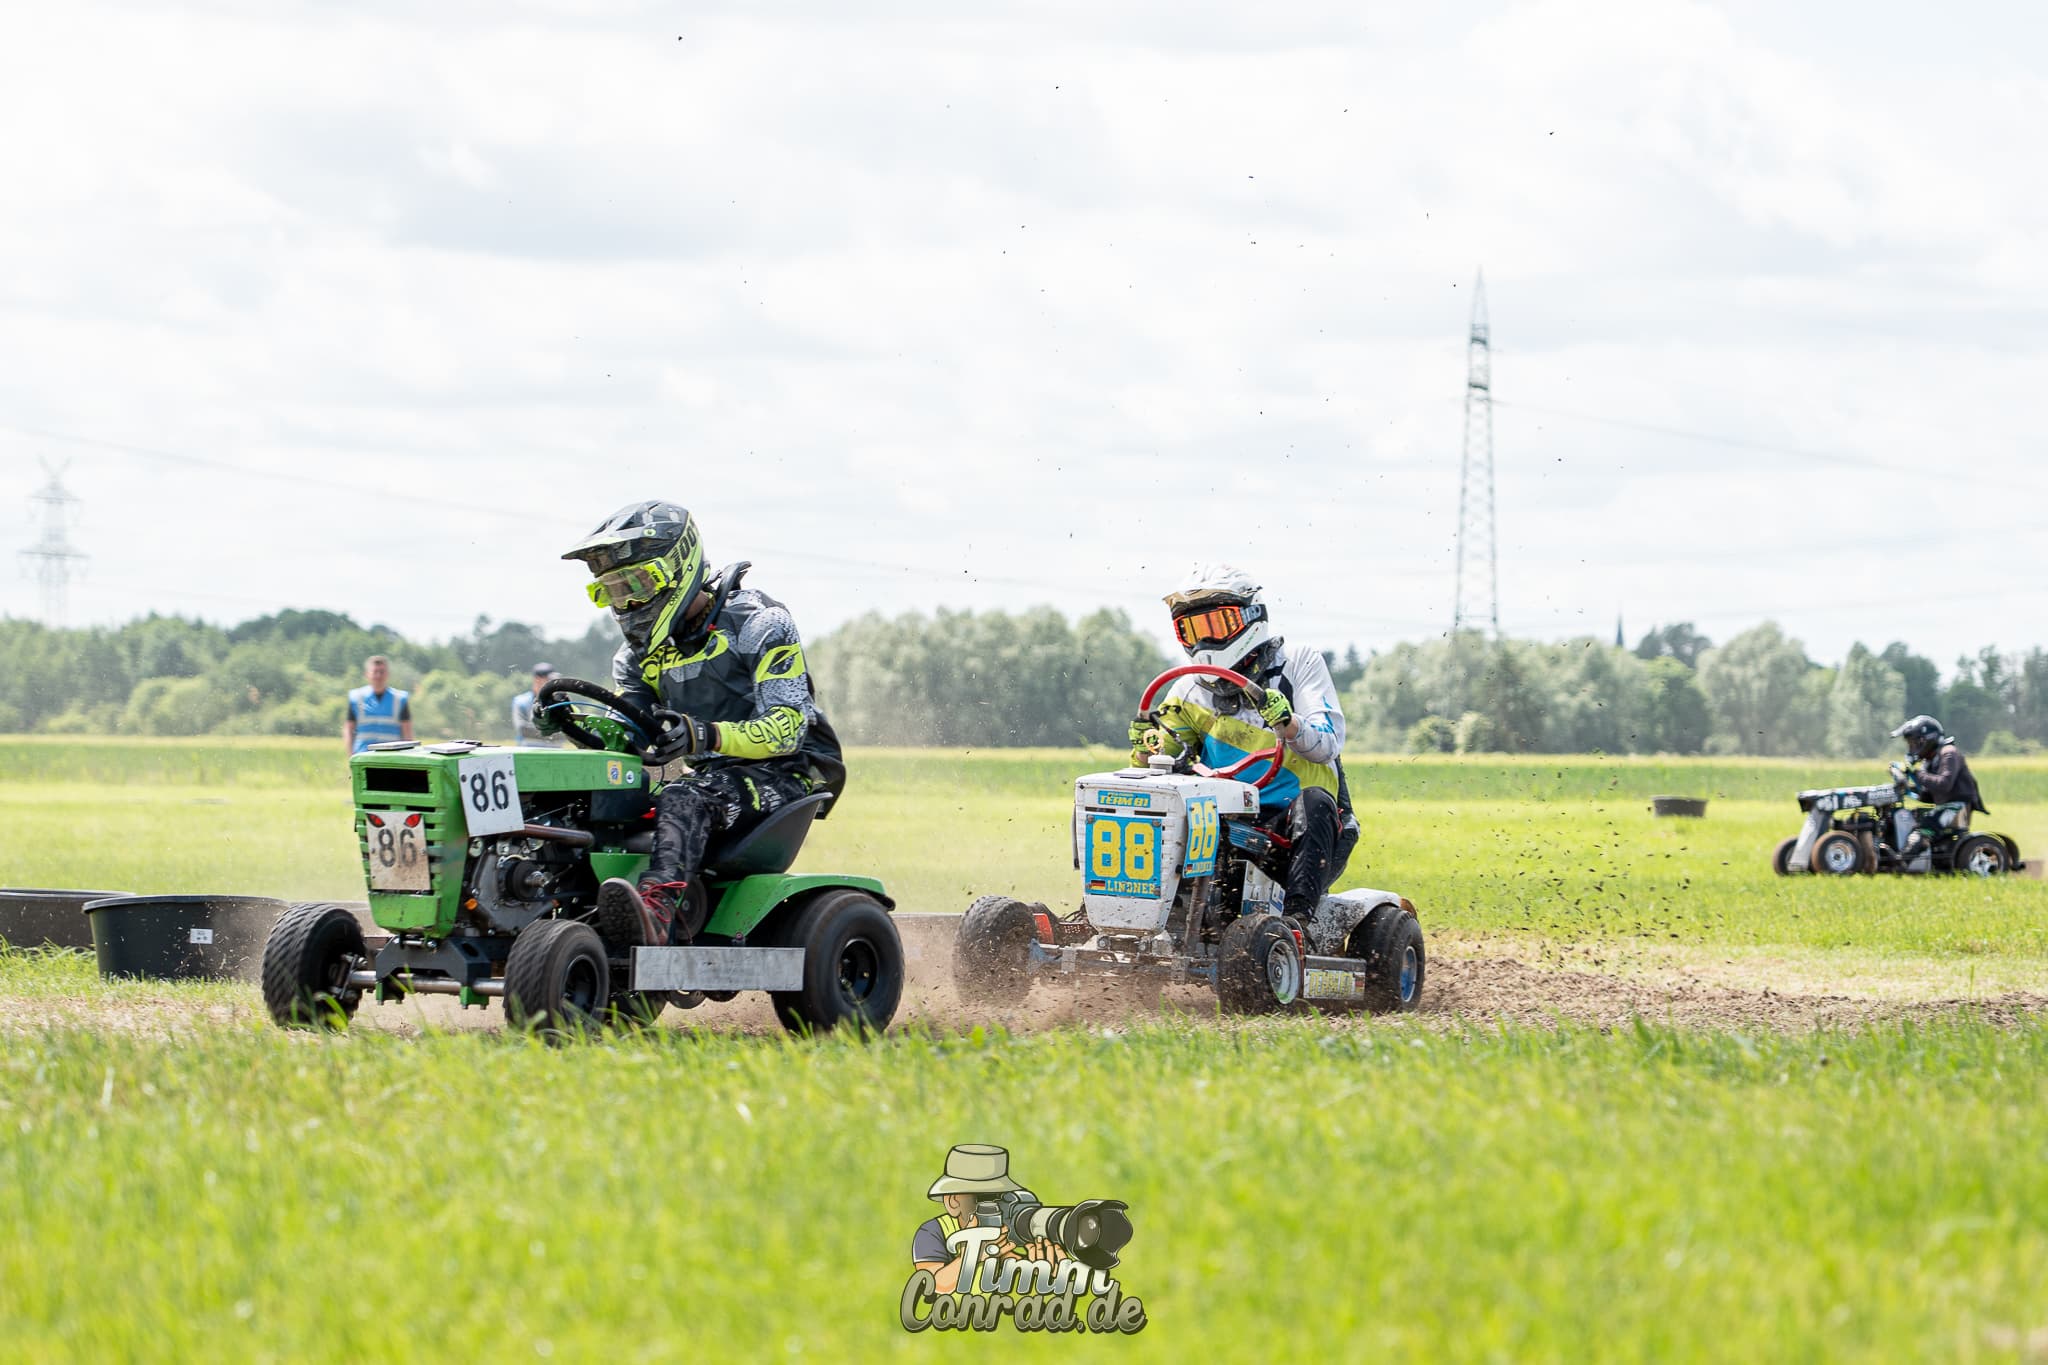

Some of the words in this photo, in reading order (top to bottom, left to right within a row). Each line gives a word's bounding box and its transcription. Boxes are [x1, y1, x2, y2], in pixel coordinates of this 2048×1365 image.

[469, 770, 510, 814] 86
[377, 828, 418, 868] 86
[1092, 819, 1155, 881] 88
[1189, 801, 1216, 861] 88
